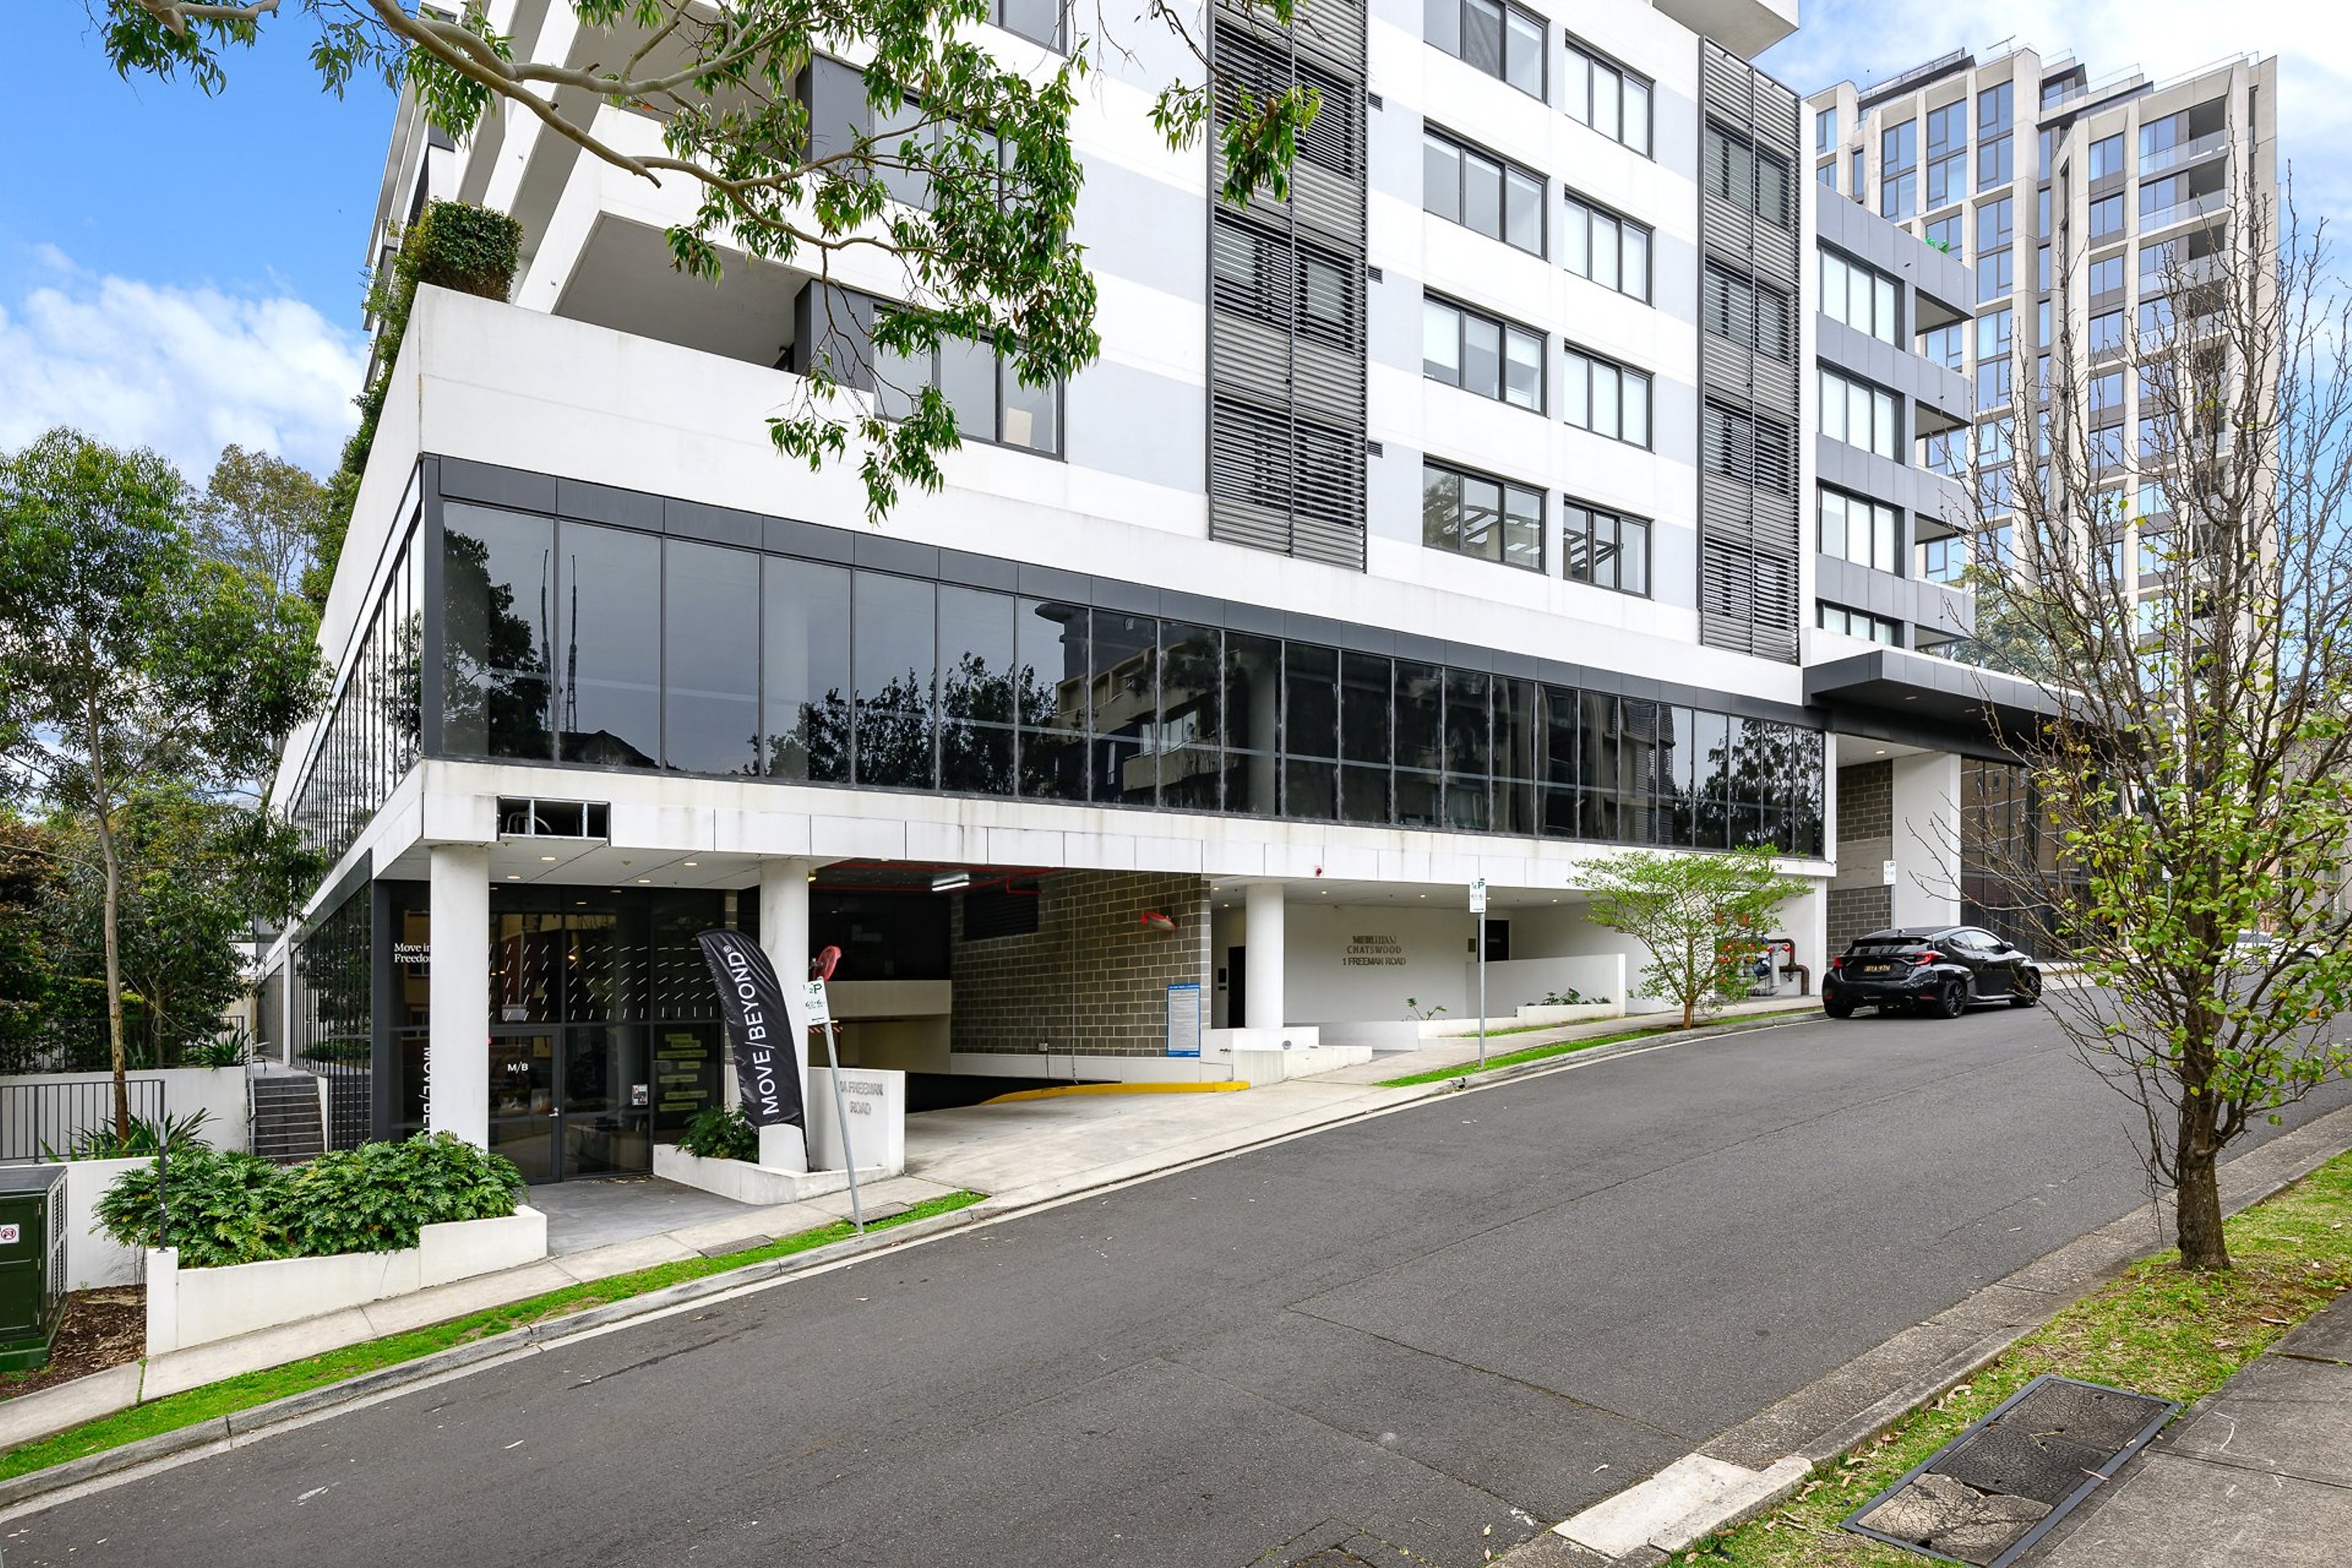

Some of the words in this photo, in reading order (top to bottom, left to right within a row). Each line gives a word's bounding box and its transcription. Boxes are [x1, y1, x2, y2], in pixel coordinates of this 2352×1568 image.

[394, 942, 422, 952] Move
[1347, 945, 1402, 955] CHATSWOOD
[394, 953, 431, 963] Freedo
[1348, 957, 1384, 966] FREEMAN
[1385, 957, 1406, 966] ROAD
[507, 1062, 529, 1074] M/B
